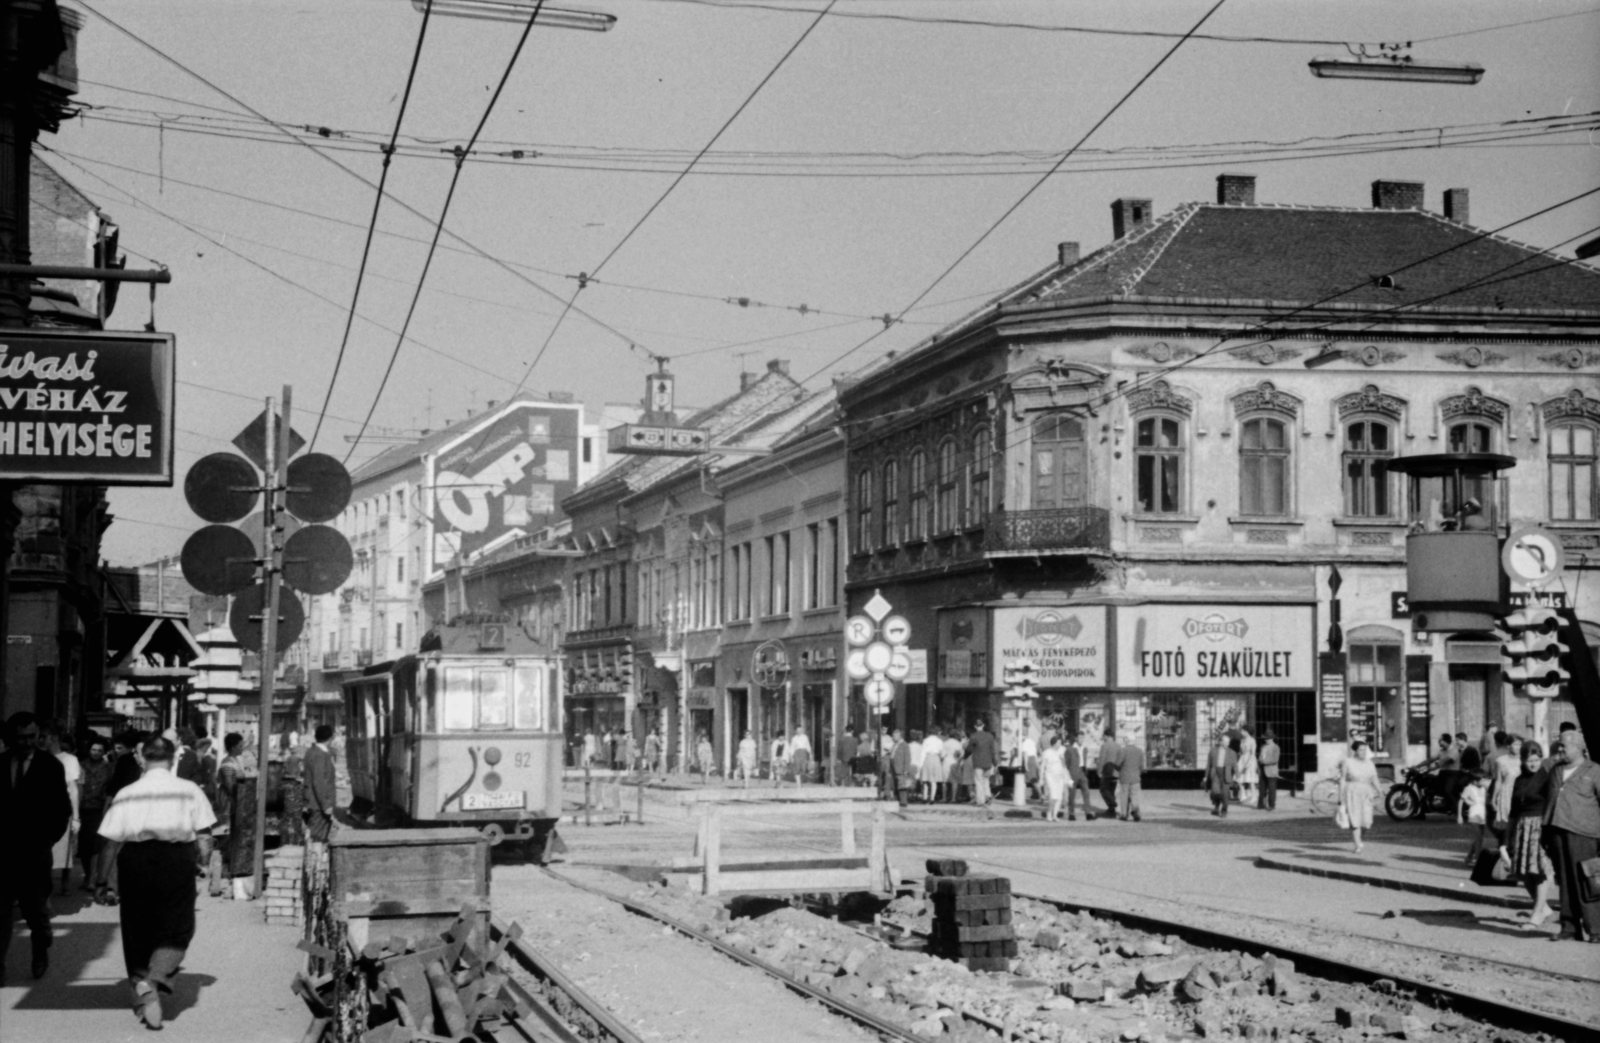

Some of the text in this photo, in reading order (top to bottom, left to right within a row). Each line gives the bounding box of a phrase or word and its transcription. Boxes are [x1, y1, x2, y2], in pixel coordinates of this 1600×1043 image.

[0, 382, 128, 412] VÉHÁZ
[488, 627, 499, 645] 2
[1141, 646, 1292, 677] FOTÓ SZAKÜZLET
[514, 752, 531, 768] 92
[469, 796, 476, 807] 2
